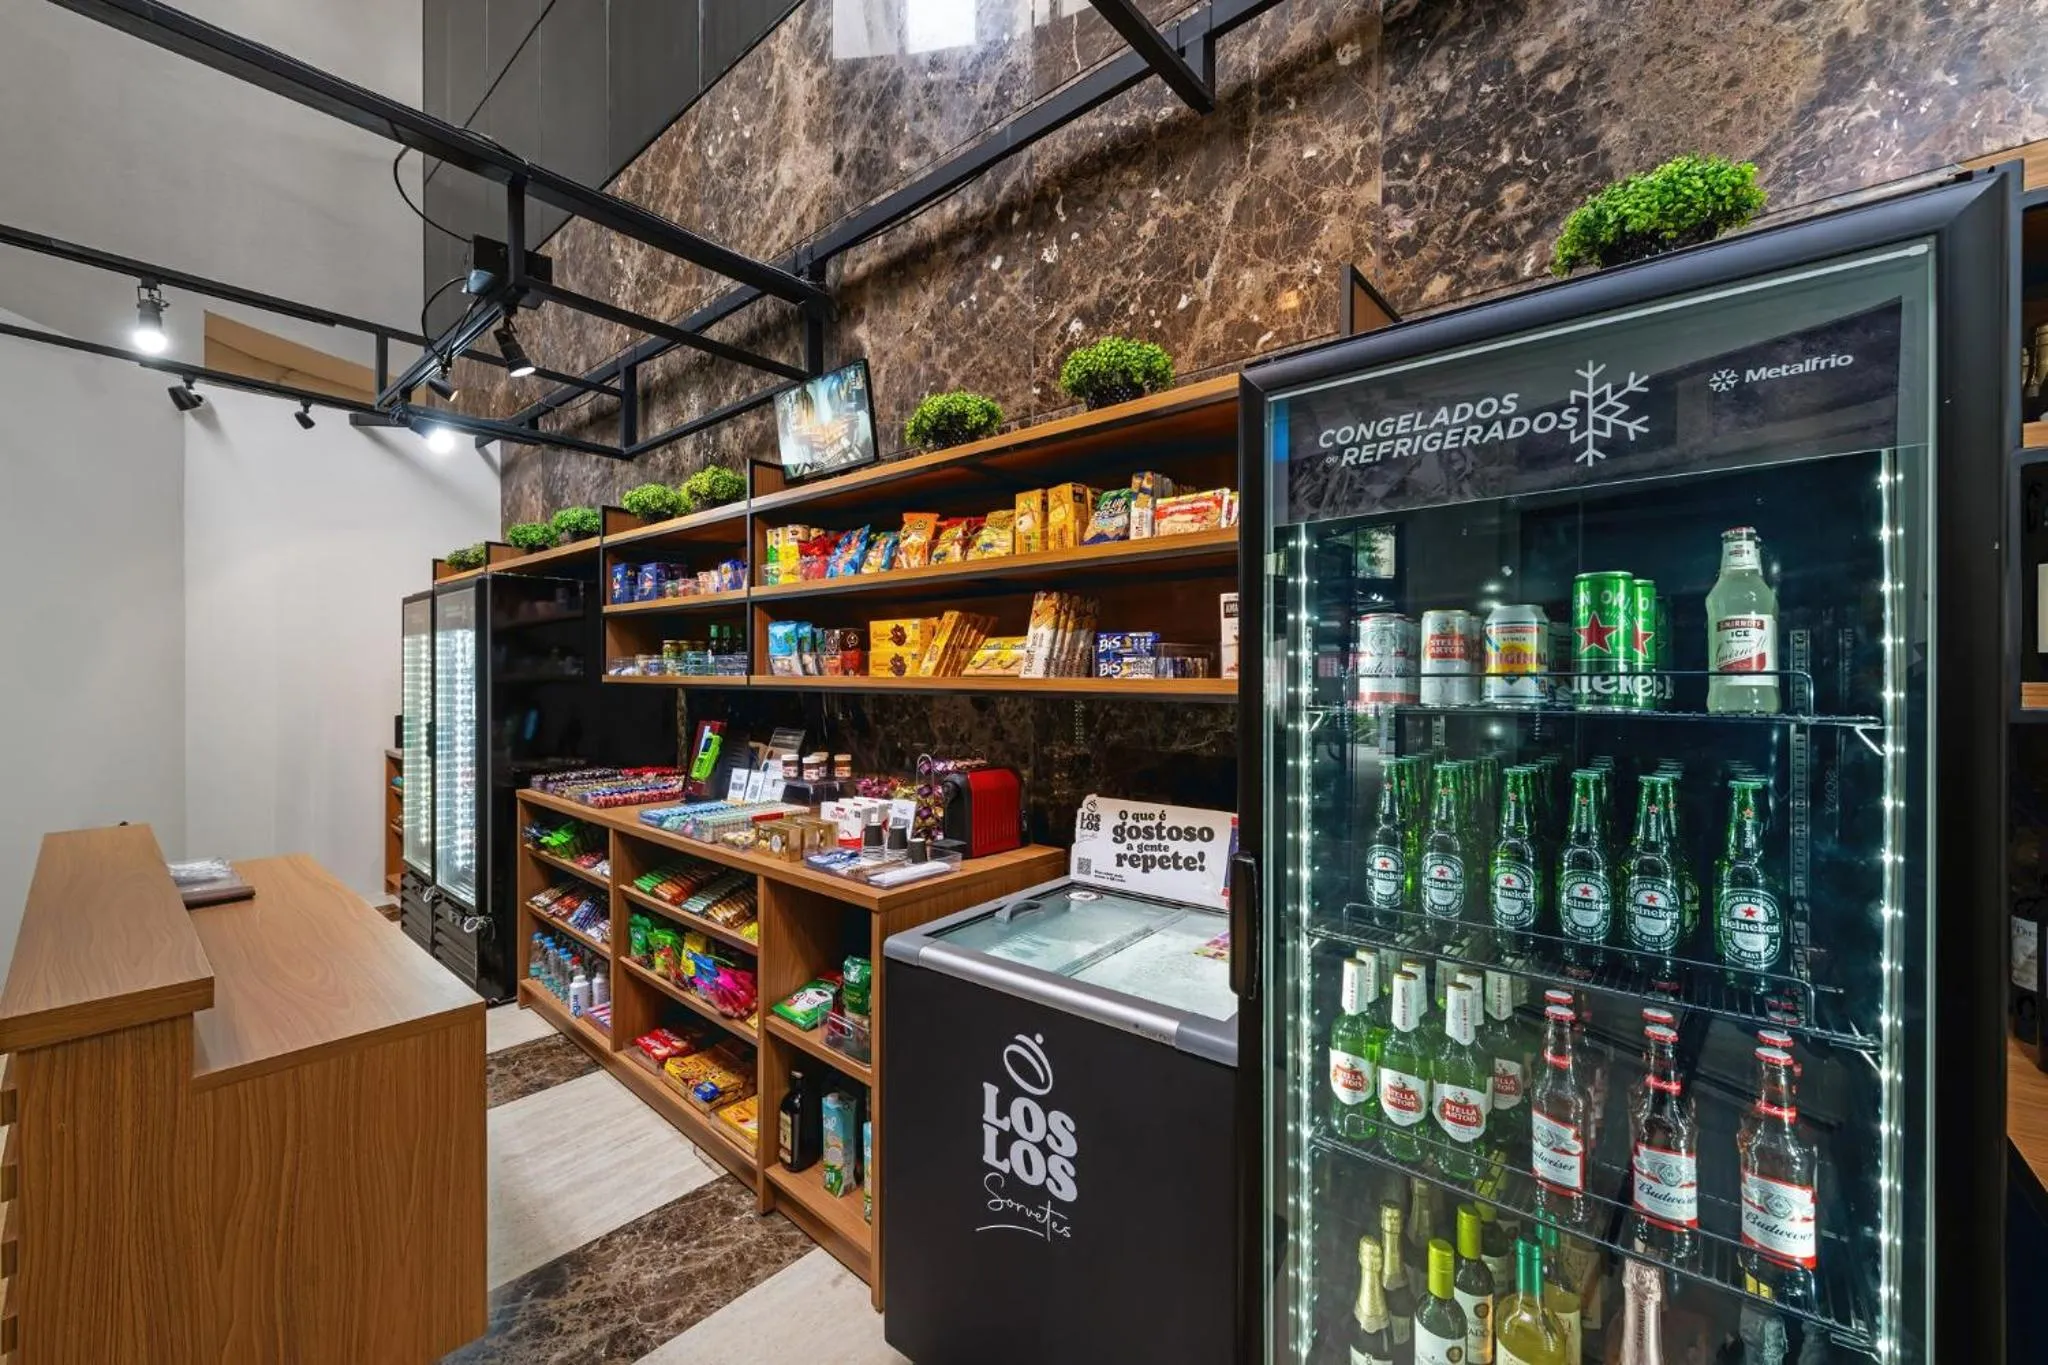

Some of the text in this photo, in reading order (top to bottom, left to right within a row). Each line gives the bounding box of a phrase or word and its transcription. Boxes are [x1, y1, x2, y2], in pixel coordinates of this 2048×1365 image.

[1745, 354, 1854, 383] Metalfrio
[1318, 393, 1519, 449] CONGELADOS
[1341, 407, 1579, 467] REFRIGERADOS
[1081, 812, 1101, 822] LOS
[1118, 810, 1167, 823] O que é
[1080, 821, 1100, 832] LOS
[1112, 821, 1215, 844] gostoso
[1126, 843, 1170, 853] a gente
[1116, 851, 1206, 874] repete!
[1561, 896, 1611, 911] Heineken
[1626, 902, 1679, 919] Heineken
[1720, 917, 1780, 933] Heineken
[1445, 1102, 1477, 1116] STELLA
[1445, 1109, 1477, 1123] ARTOIS
[983, 1082, 1078, 1158] LOS
[983, 1123, 1078, 1202] LOS
[983, 1173, 1071, 1241] Sorvetes
